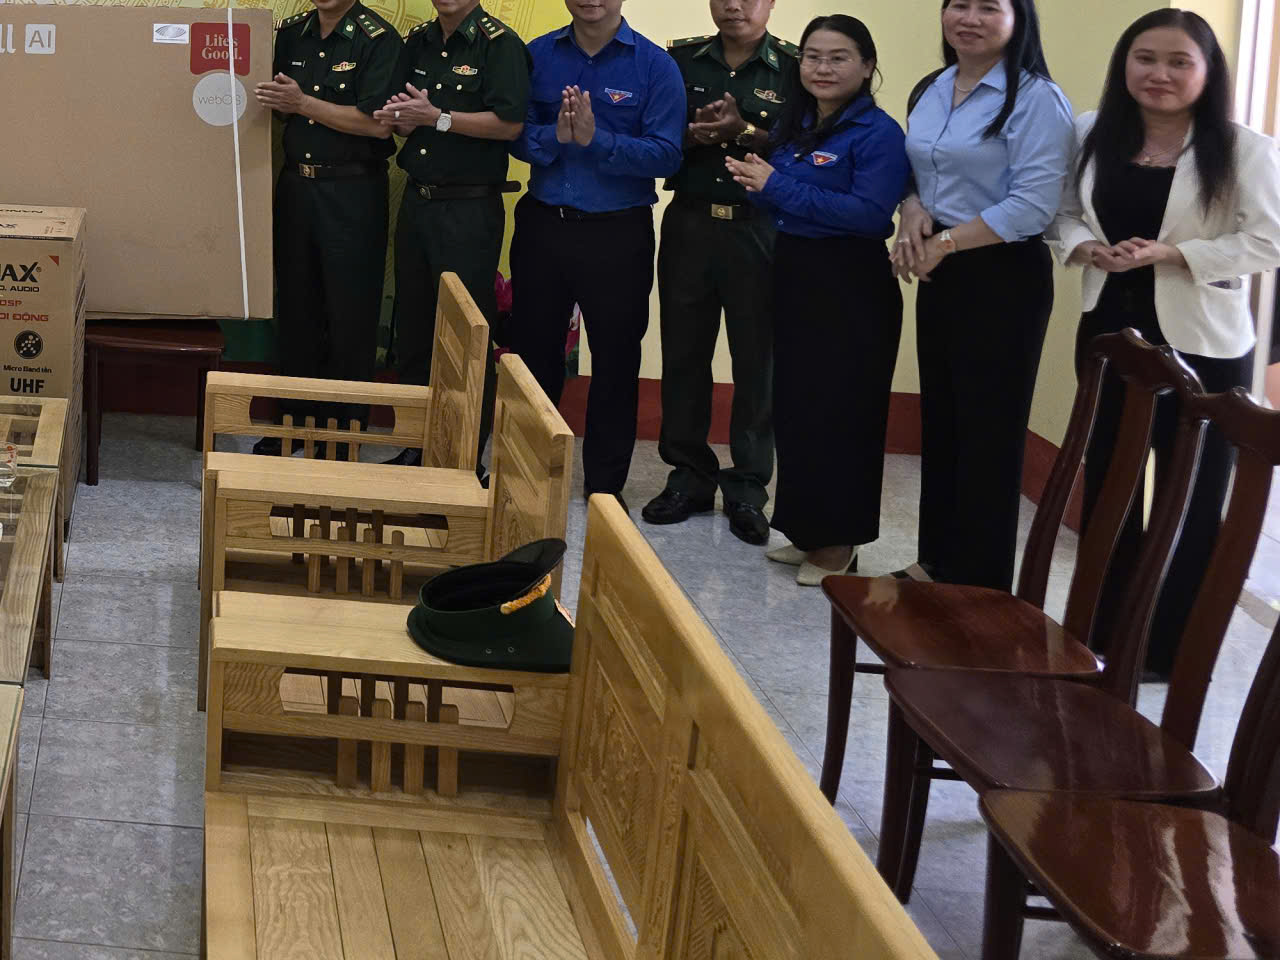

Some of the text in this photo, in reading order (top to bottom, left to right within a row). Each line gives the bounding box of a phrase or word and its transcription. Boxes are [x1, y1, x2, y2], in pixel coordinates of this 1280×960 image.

[27, 28, 53, 51] AI
[205, 34, 238, 47] Lifes
[10, 285, 40, 293] AUDIO
[12, 312, 49, 323] ĐỘNG
[10, 377, 45, 393] UHF
